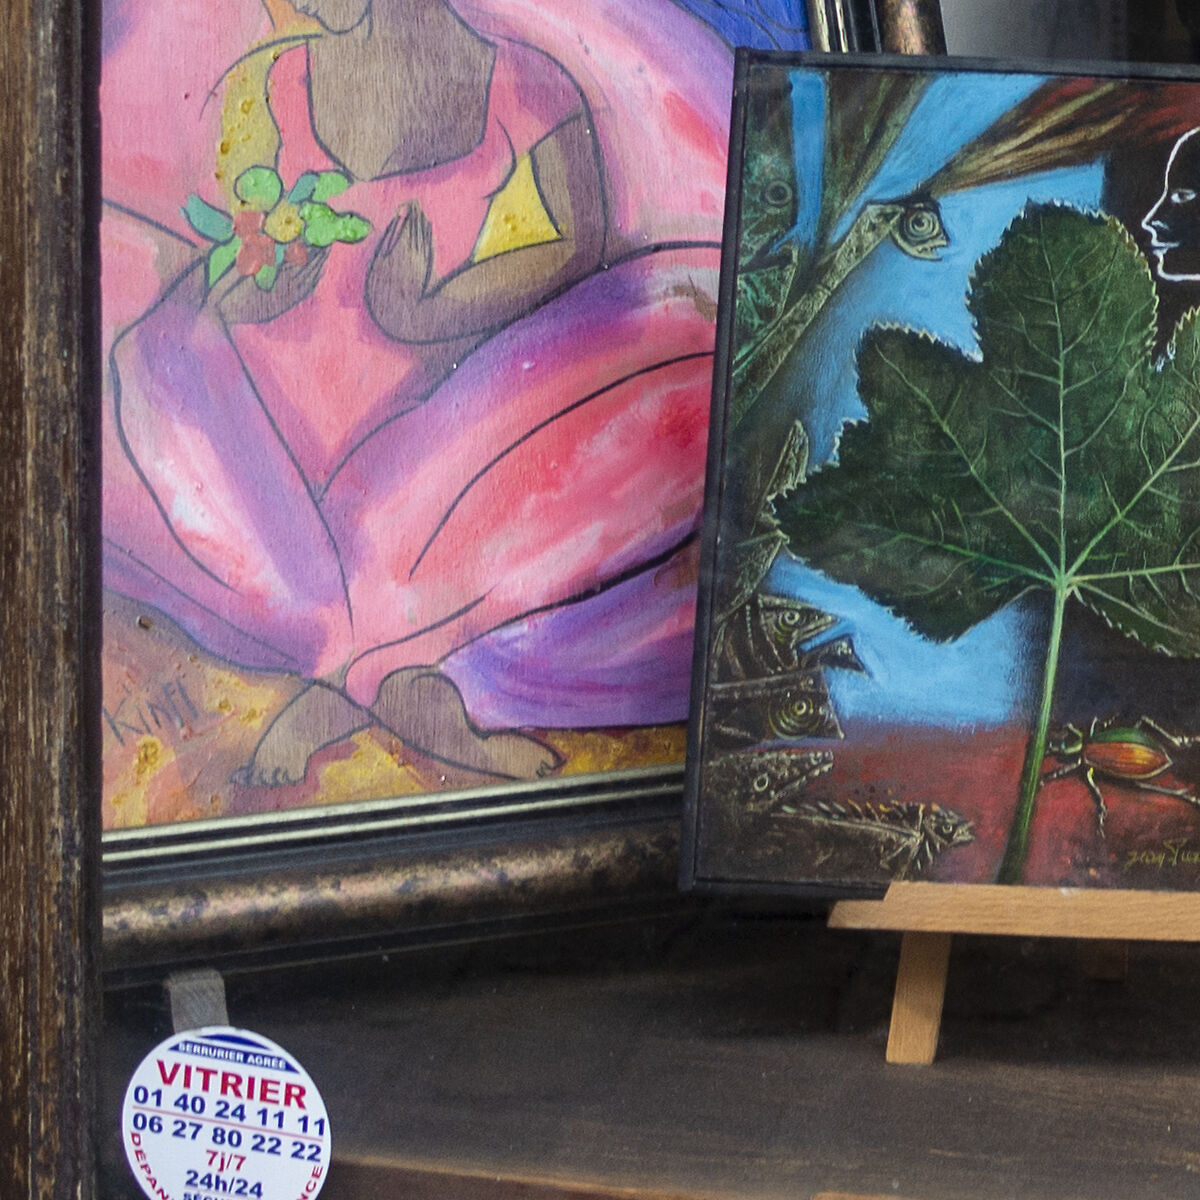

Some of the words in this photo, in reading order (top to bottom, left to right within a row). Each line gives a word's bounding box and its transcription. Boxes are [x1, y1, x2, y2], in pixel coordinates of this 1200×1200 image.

[178, 1041, 244, 1063] SERRURIER
[156, 1059, 307, 1110] VITRIER
[134, 1086, 163, 1107] 01
[174, 1093, 206, 1114] 40
[215, 1100, 246, 1122] 24
[257, 1108, 285, 1129] 11
[298, 1115, 326, 1136] 11
[133, 1113, 163, 1134] 06
[172, 1119, 203, 1140] 27
[211, 1127, 242, 1148] 80
[251, 1134, 282, 1155] 22
[291, 1141, 322, 1162] 22
[206, 1149, 247, 1172] 7j/7
[185, 1170, 263, 1199] 24h/24
